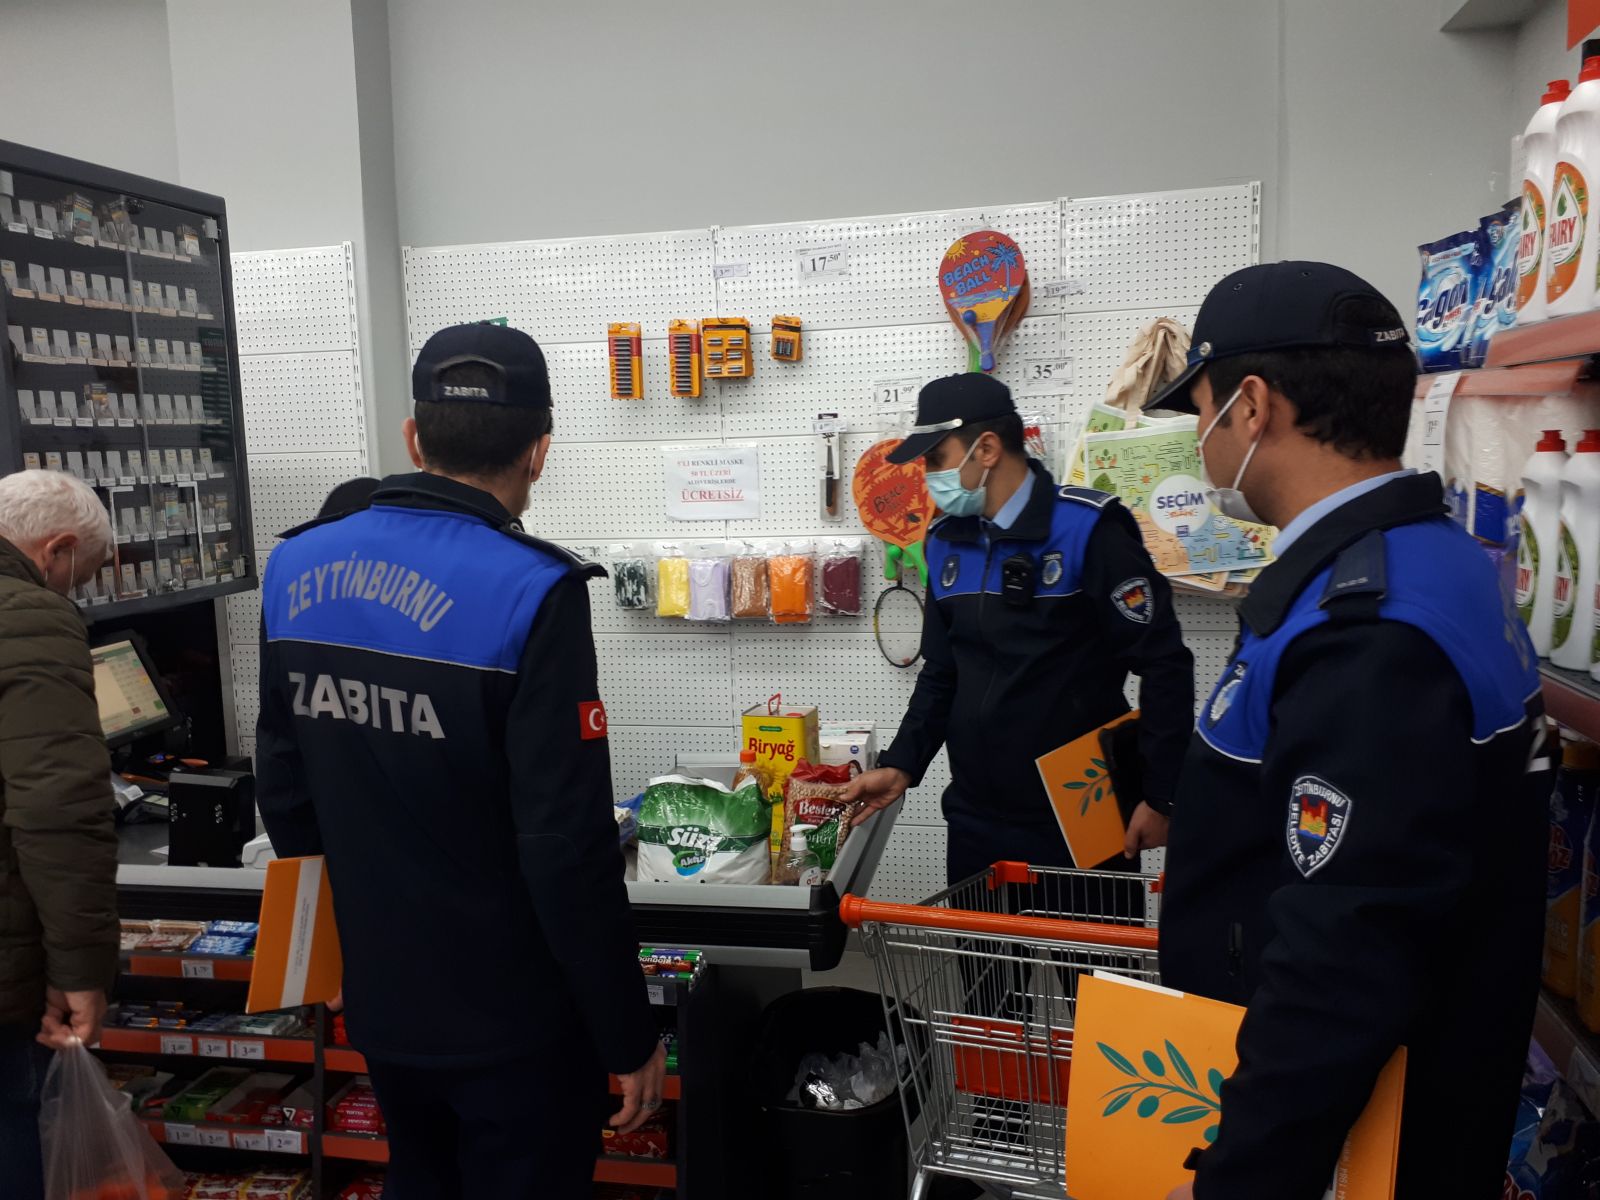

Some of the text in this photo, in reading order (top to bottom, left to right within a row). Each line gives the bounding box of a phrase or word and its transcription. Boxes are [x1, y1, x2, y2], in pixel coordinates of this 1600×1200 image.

[943, 255, 990, 287] BEACH
[955, 272, 992, 296] BALL
[444, 386, 489, 398] ZABITA
[681, 488, 743, 500] ÜCRETSİZ
[1157, 490, 1204, 511] SEÇİM
[288, 551, 454, 632] ZEYTİNBURNU
[288, 671, 446, 739] ZABITA
[749, 737, 796, 762] Biryağ
